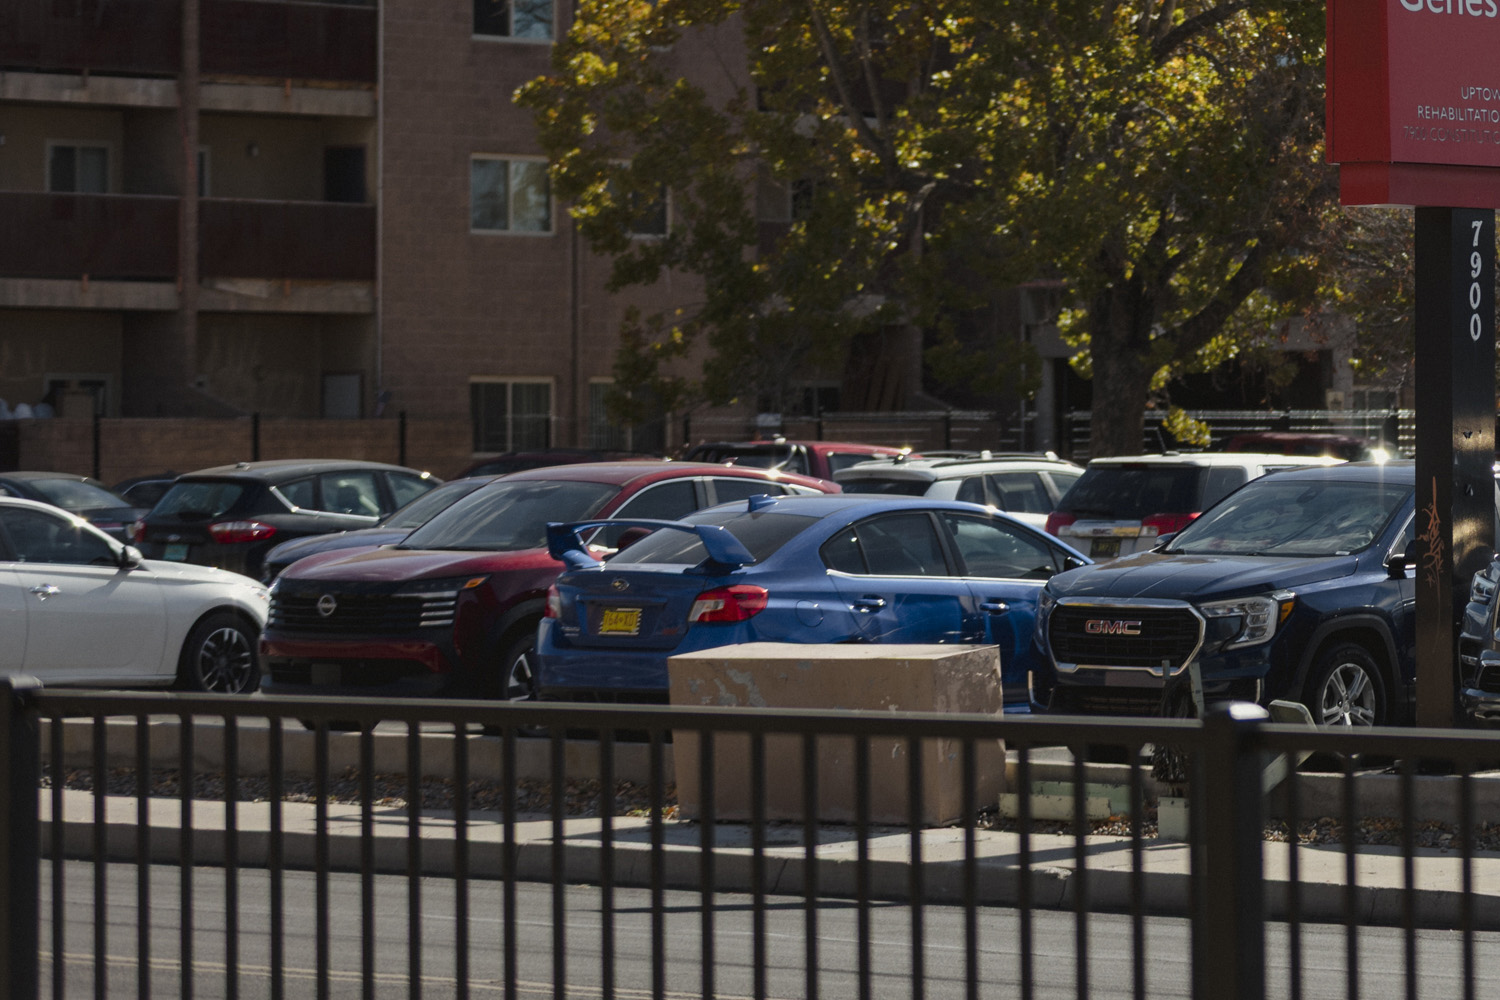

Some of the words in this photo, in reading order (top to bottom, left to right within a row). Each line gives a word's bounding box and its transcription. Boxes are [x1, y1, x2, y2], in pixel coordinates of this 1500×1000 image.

[1403, 125, 1427, 141] 7900
[1469, 220, 1483, 341] 7900
[1085, 619, 1142, 635] GMC
